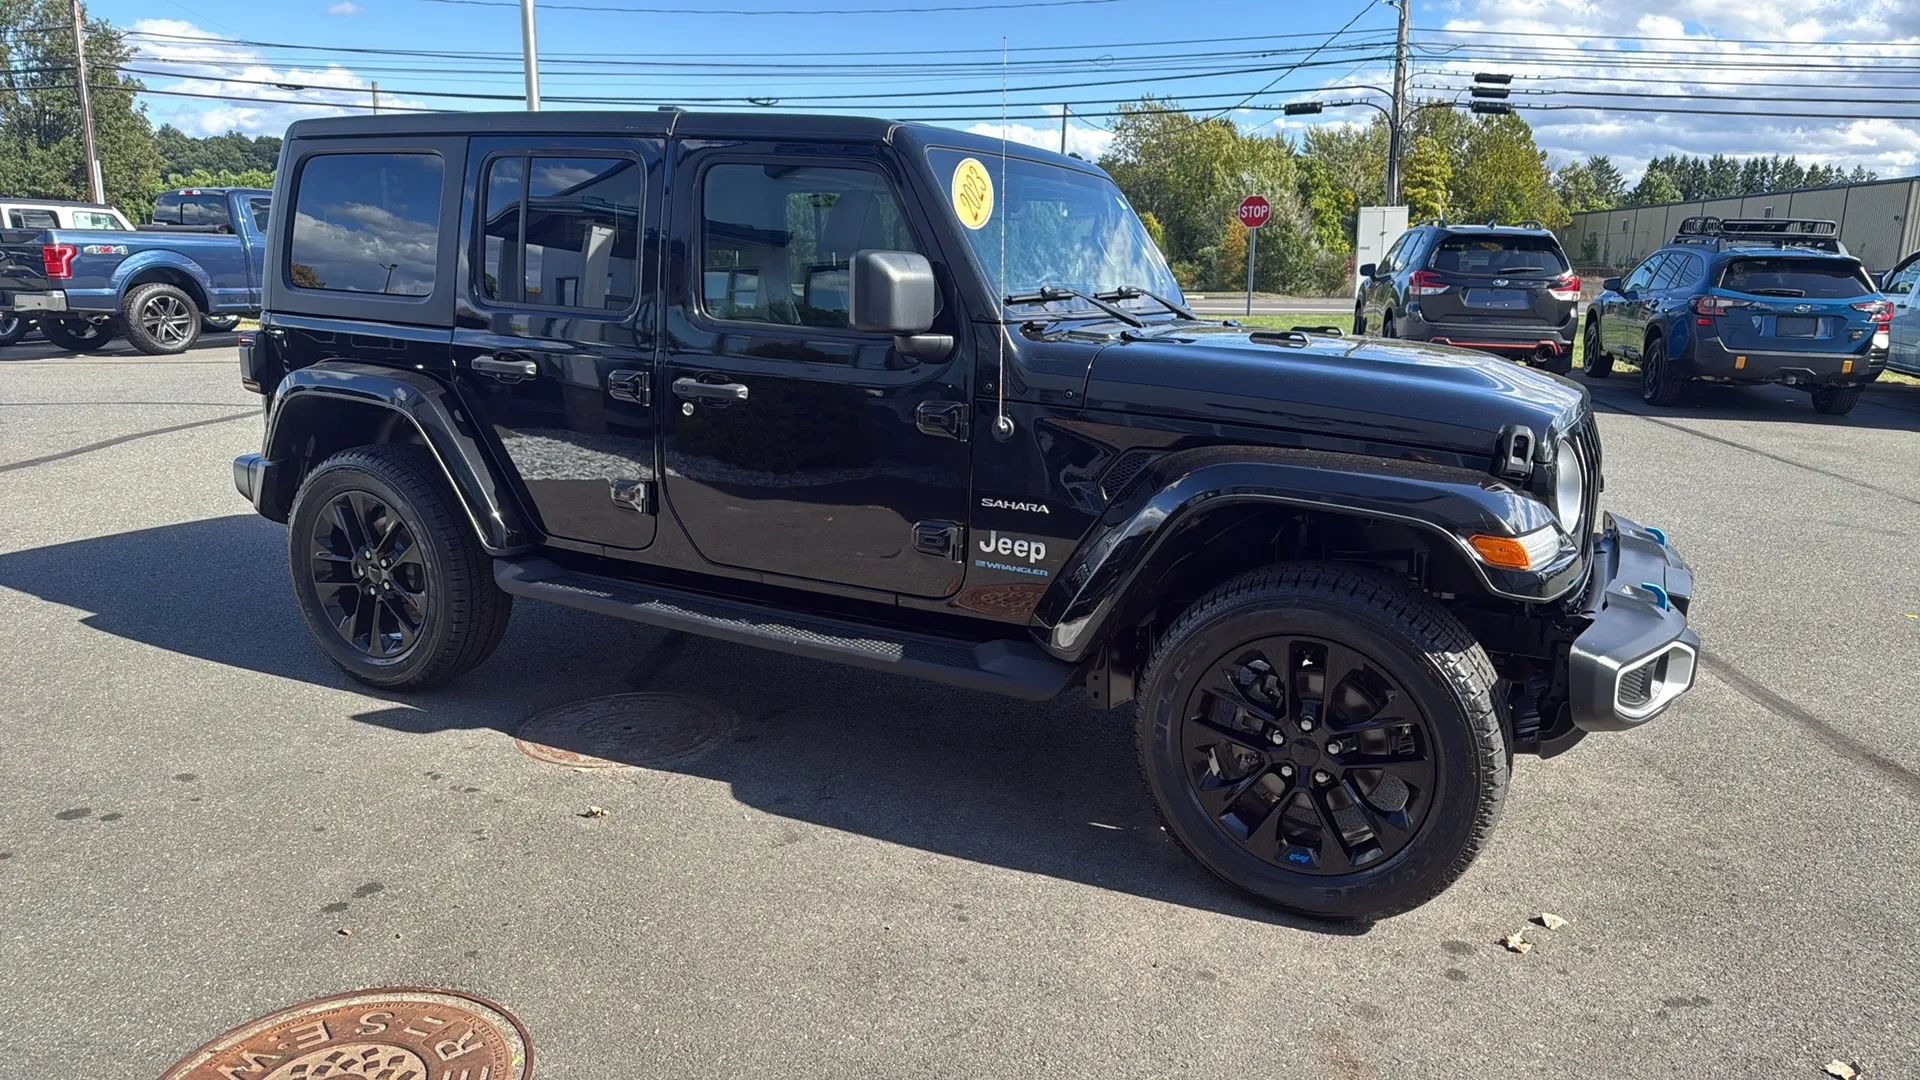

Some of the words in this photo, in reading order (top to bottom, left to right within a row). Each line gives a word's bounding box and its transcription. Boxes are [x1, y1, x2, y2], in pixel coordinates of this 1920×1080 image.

[960, 165, 987, 221] 2023
[1241, 205, 1268, 218] STOP
[981, 498, 1050, 514] SAHARA
[979, 530, 1046, 563] Jeep
